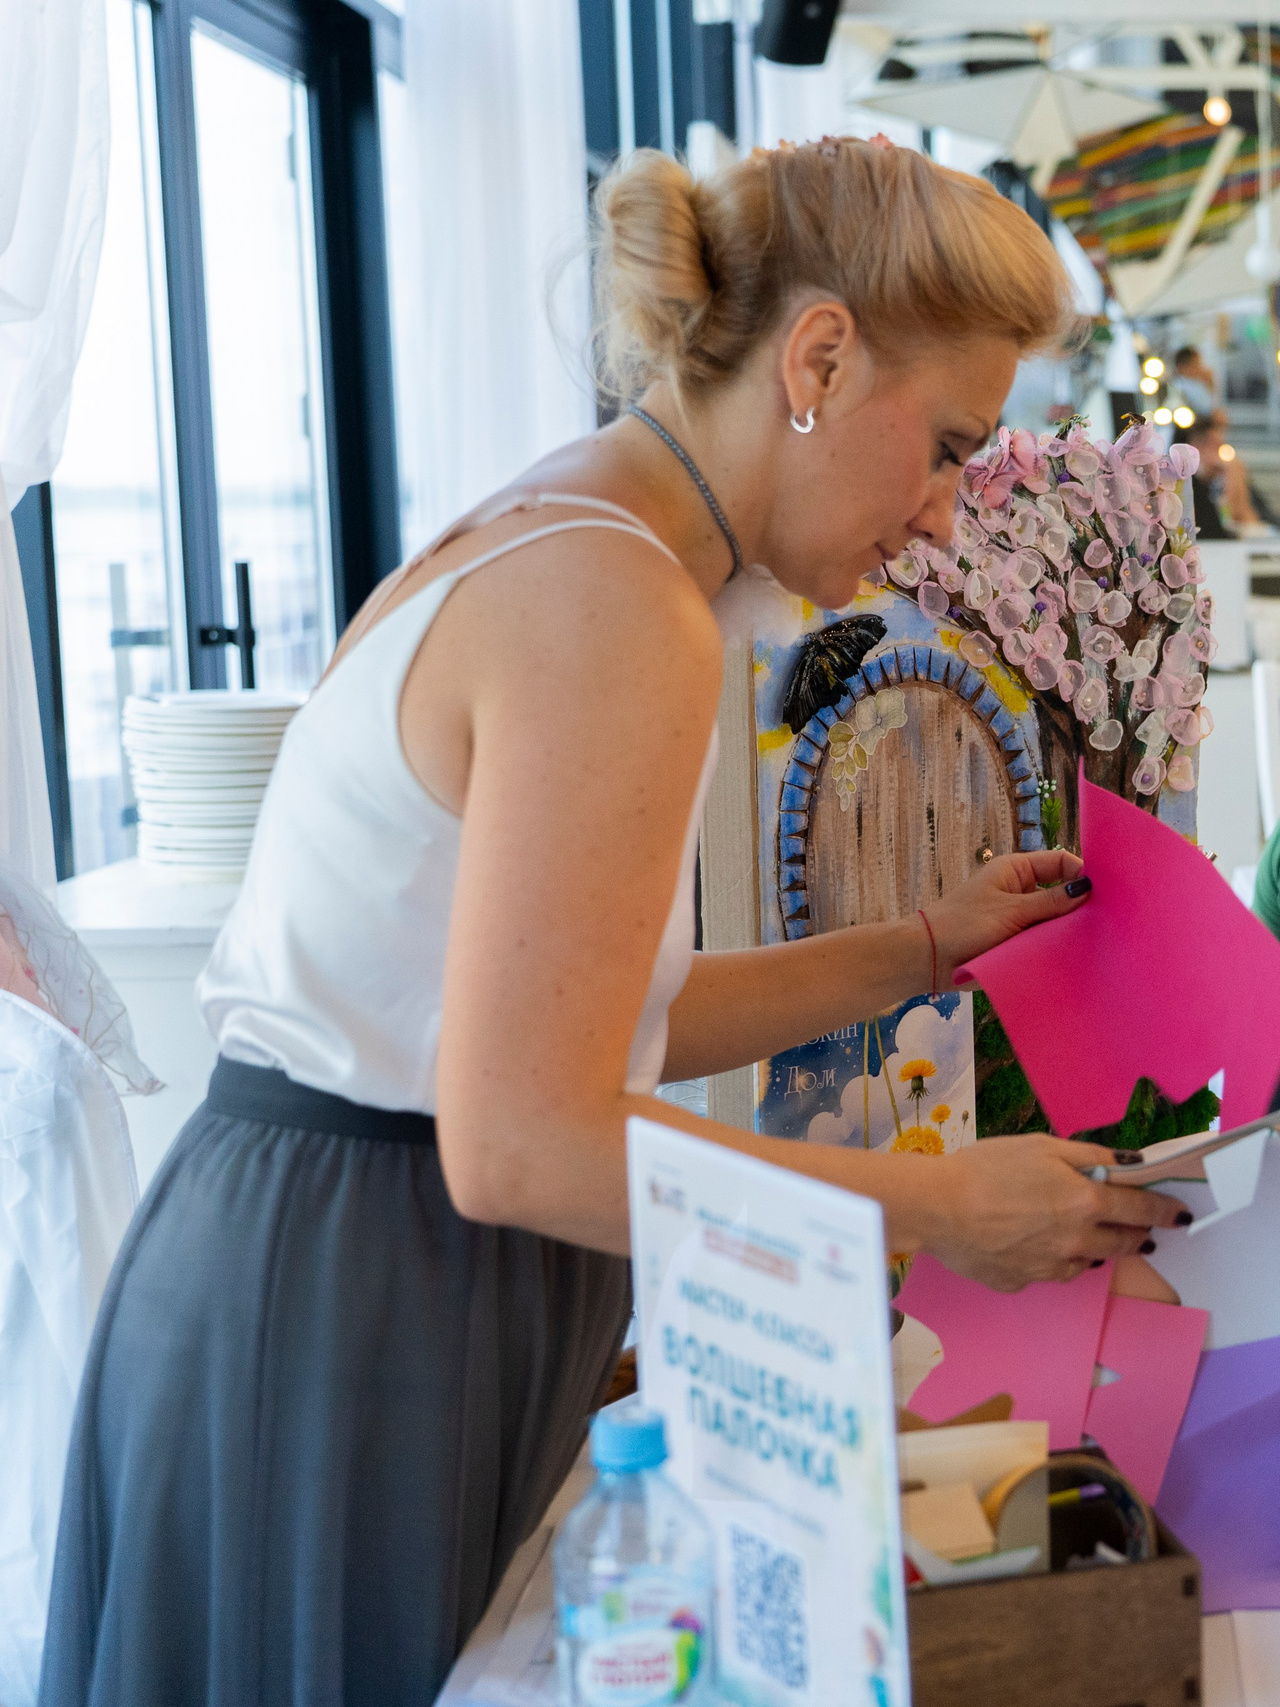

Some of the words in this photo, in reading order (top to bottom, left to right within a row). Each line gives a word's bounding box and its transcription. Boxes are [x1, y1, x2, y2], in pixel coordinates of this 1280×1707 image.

[784, 1066, 837, 1101] Дом
[663, 1323, 863, 1450] ВОЛШЕБНАЯ
[687, 1384, 842, 1497] ПАЛОЧКА
